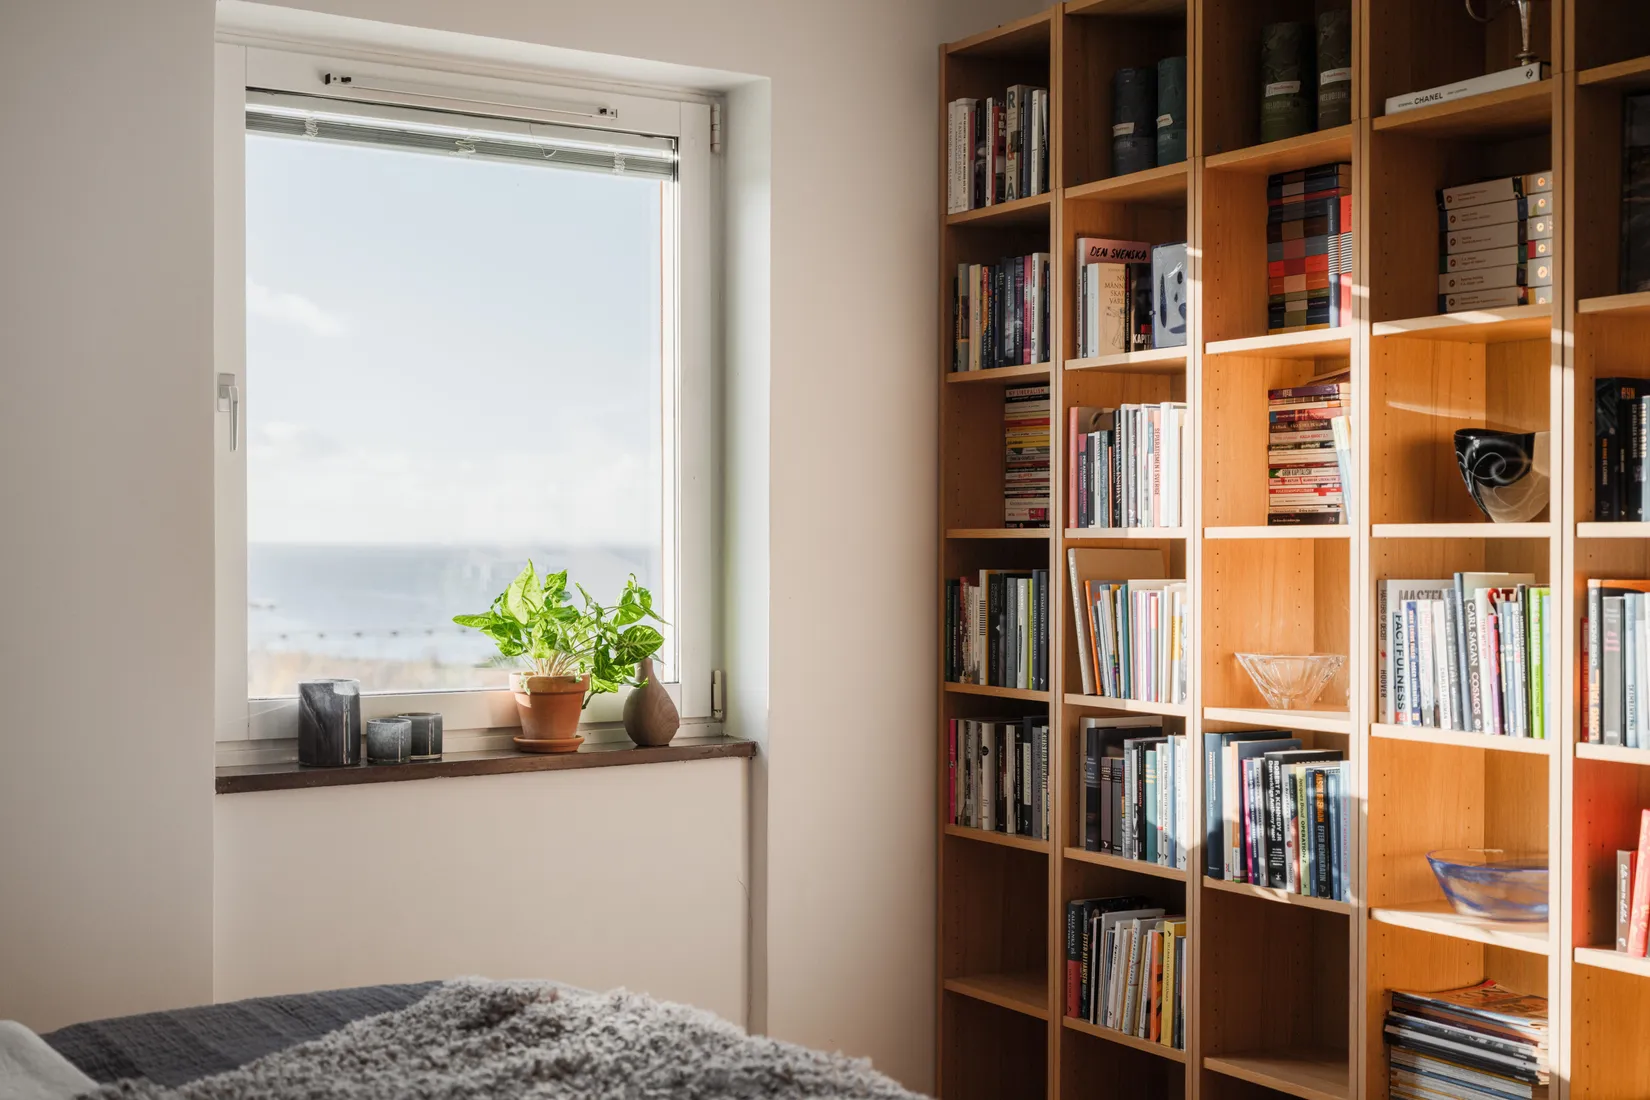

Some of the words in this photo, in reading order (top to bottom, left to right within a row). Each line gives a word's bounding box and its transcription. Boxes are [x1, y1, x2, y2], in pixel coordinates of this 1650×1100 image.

[1414, 93, 1444, 105] CHANEL
[1090, 246, 1108, 257] DEN
[1110, 248, 1147, 261] SVENSKA
[1467, 602, 1476, 630] CARL
[1396, 615, 1406, 710] FACTFULNESS
[1469, 632, 1478, 666] SAGAN
[1472, 672, 1481, 714] COSMOS
[1277, 833, 1282, 841] JR
[1318, 844, 1326, 881] DEMOKRATIN
